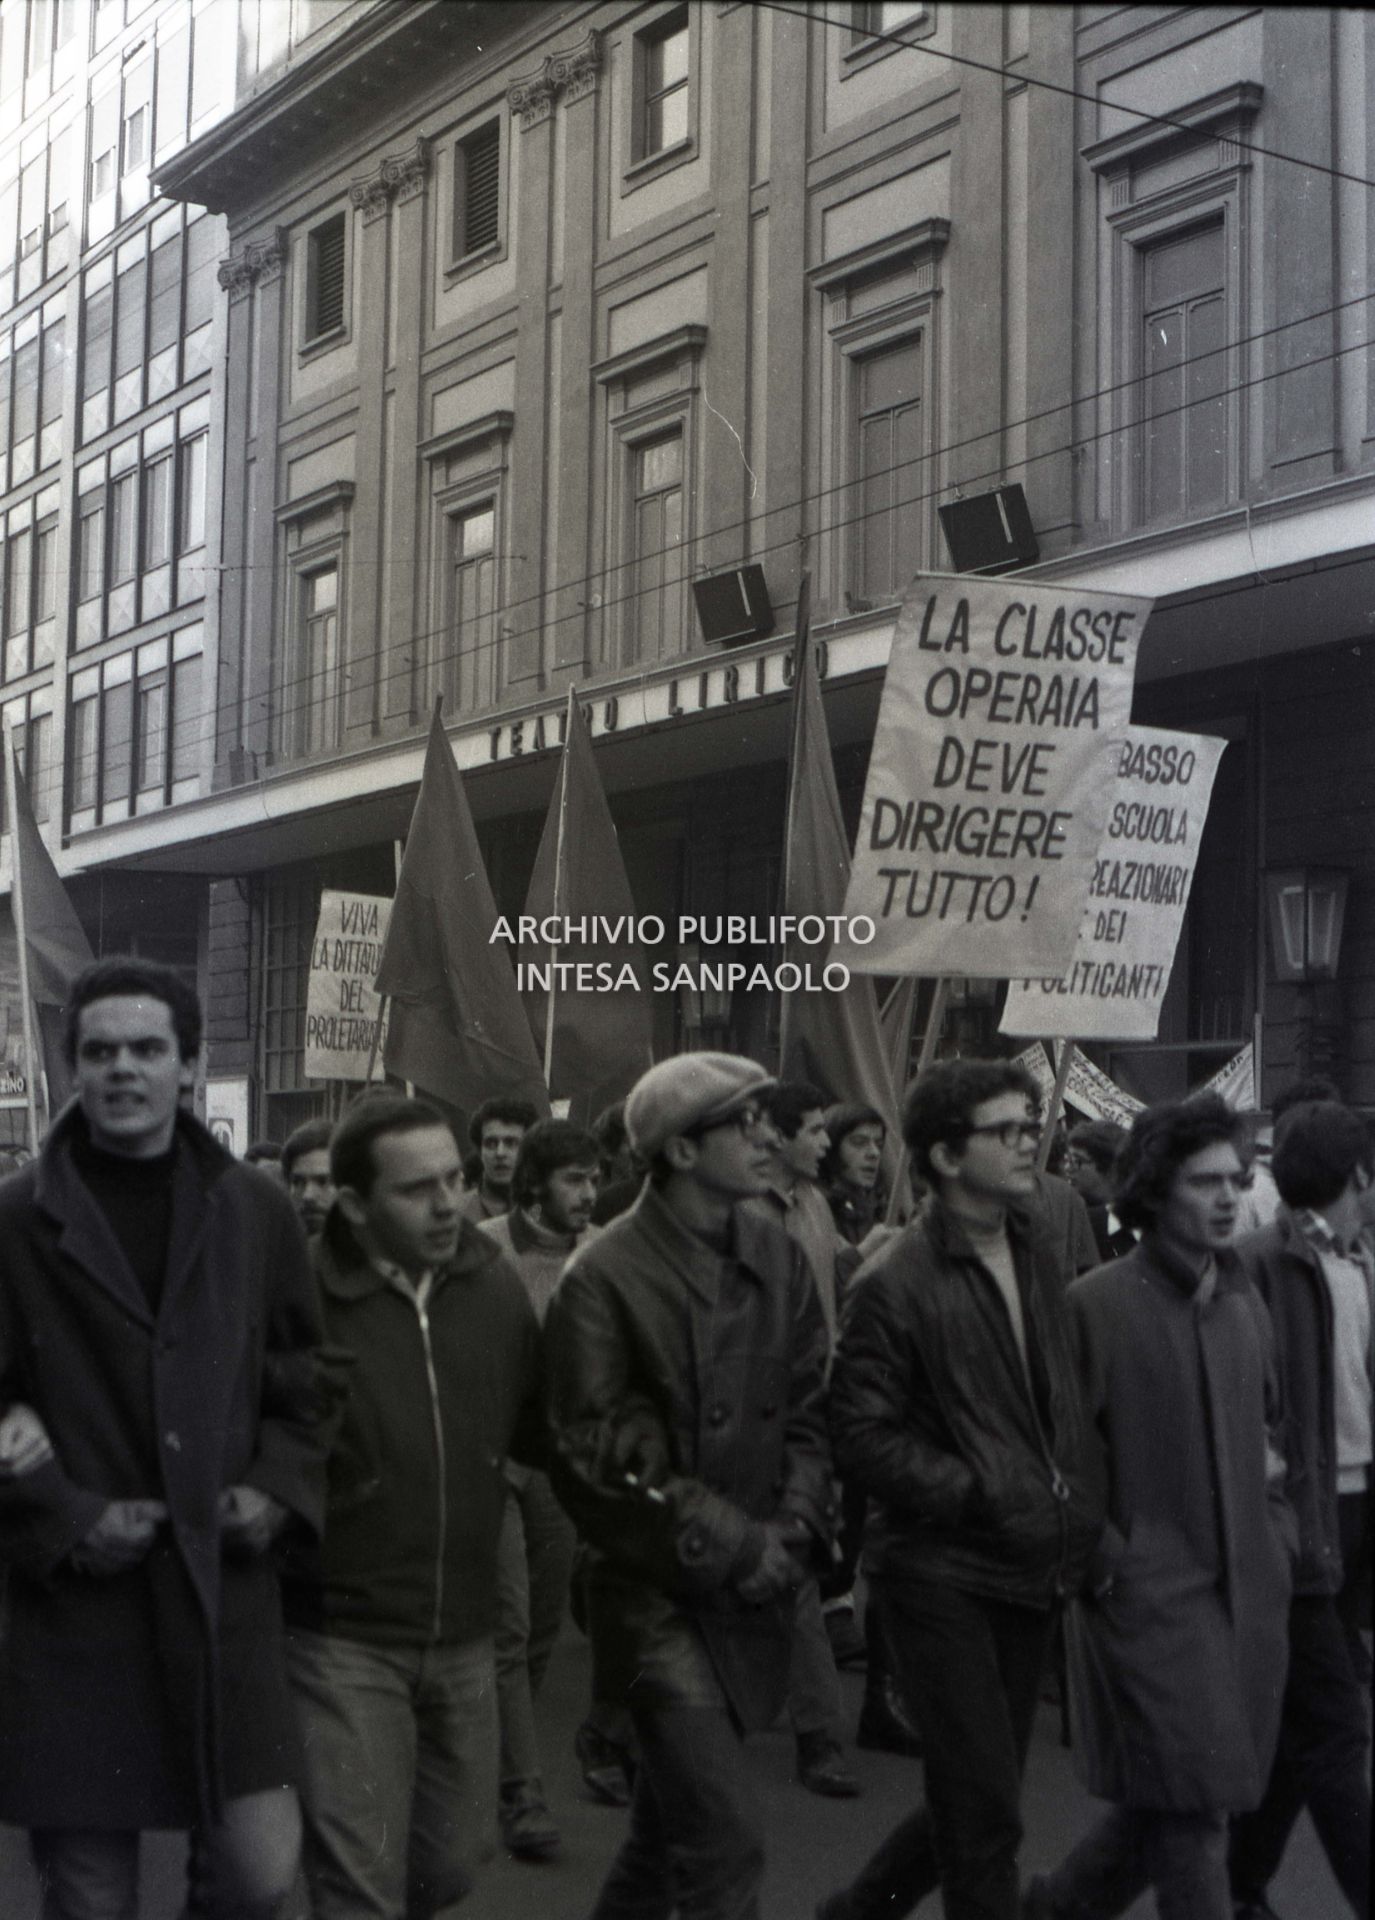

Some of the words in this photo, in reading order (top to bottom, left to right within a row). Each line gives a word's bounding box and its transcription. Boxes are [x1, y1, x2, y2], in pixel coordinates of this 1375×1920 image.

[918, 595, 970, 655] LA
[994, 602, 1136, 664] CLASSE
[669, 641, 828, 716] LIRICO
[924, 667, 1099, 729] OPERAIA
[933, 736, 1056, 795] DEVE
[1117, 740, 1196, 785] BASSO
[870, 798, 1073, 860] DIRIGERE
[1108, 802, 1187, 845] SCUOLA
[877, 868, 1041, 923] TUTTO!
[341, 901, 379, 936] VIVA
[1094, 908, 1127, 943] DEI
[312, 938, 329, 970] LA
[333, 939, 384, 976] DITTATU
[340, 979, 364, 1013] DEL
[307, 1015, 389, 1052] PROLETARIAO
